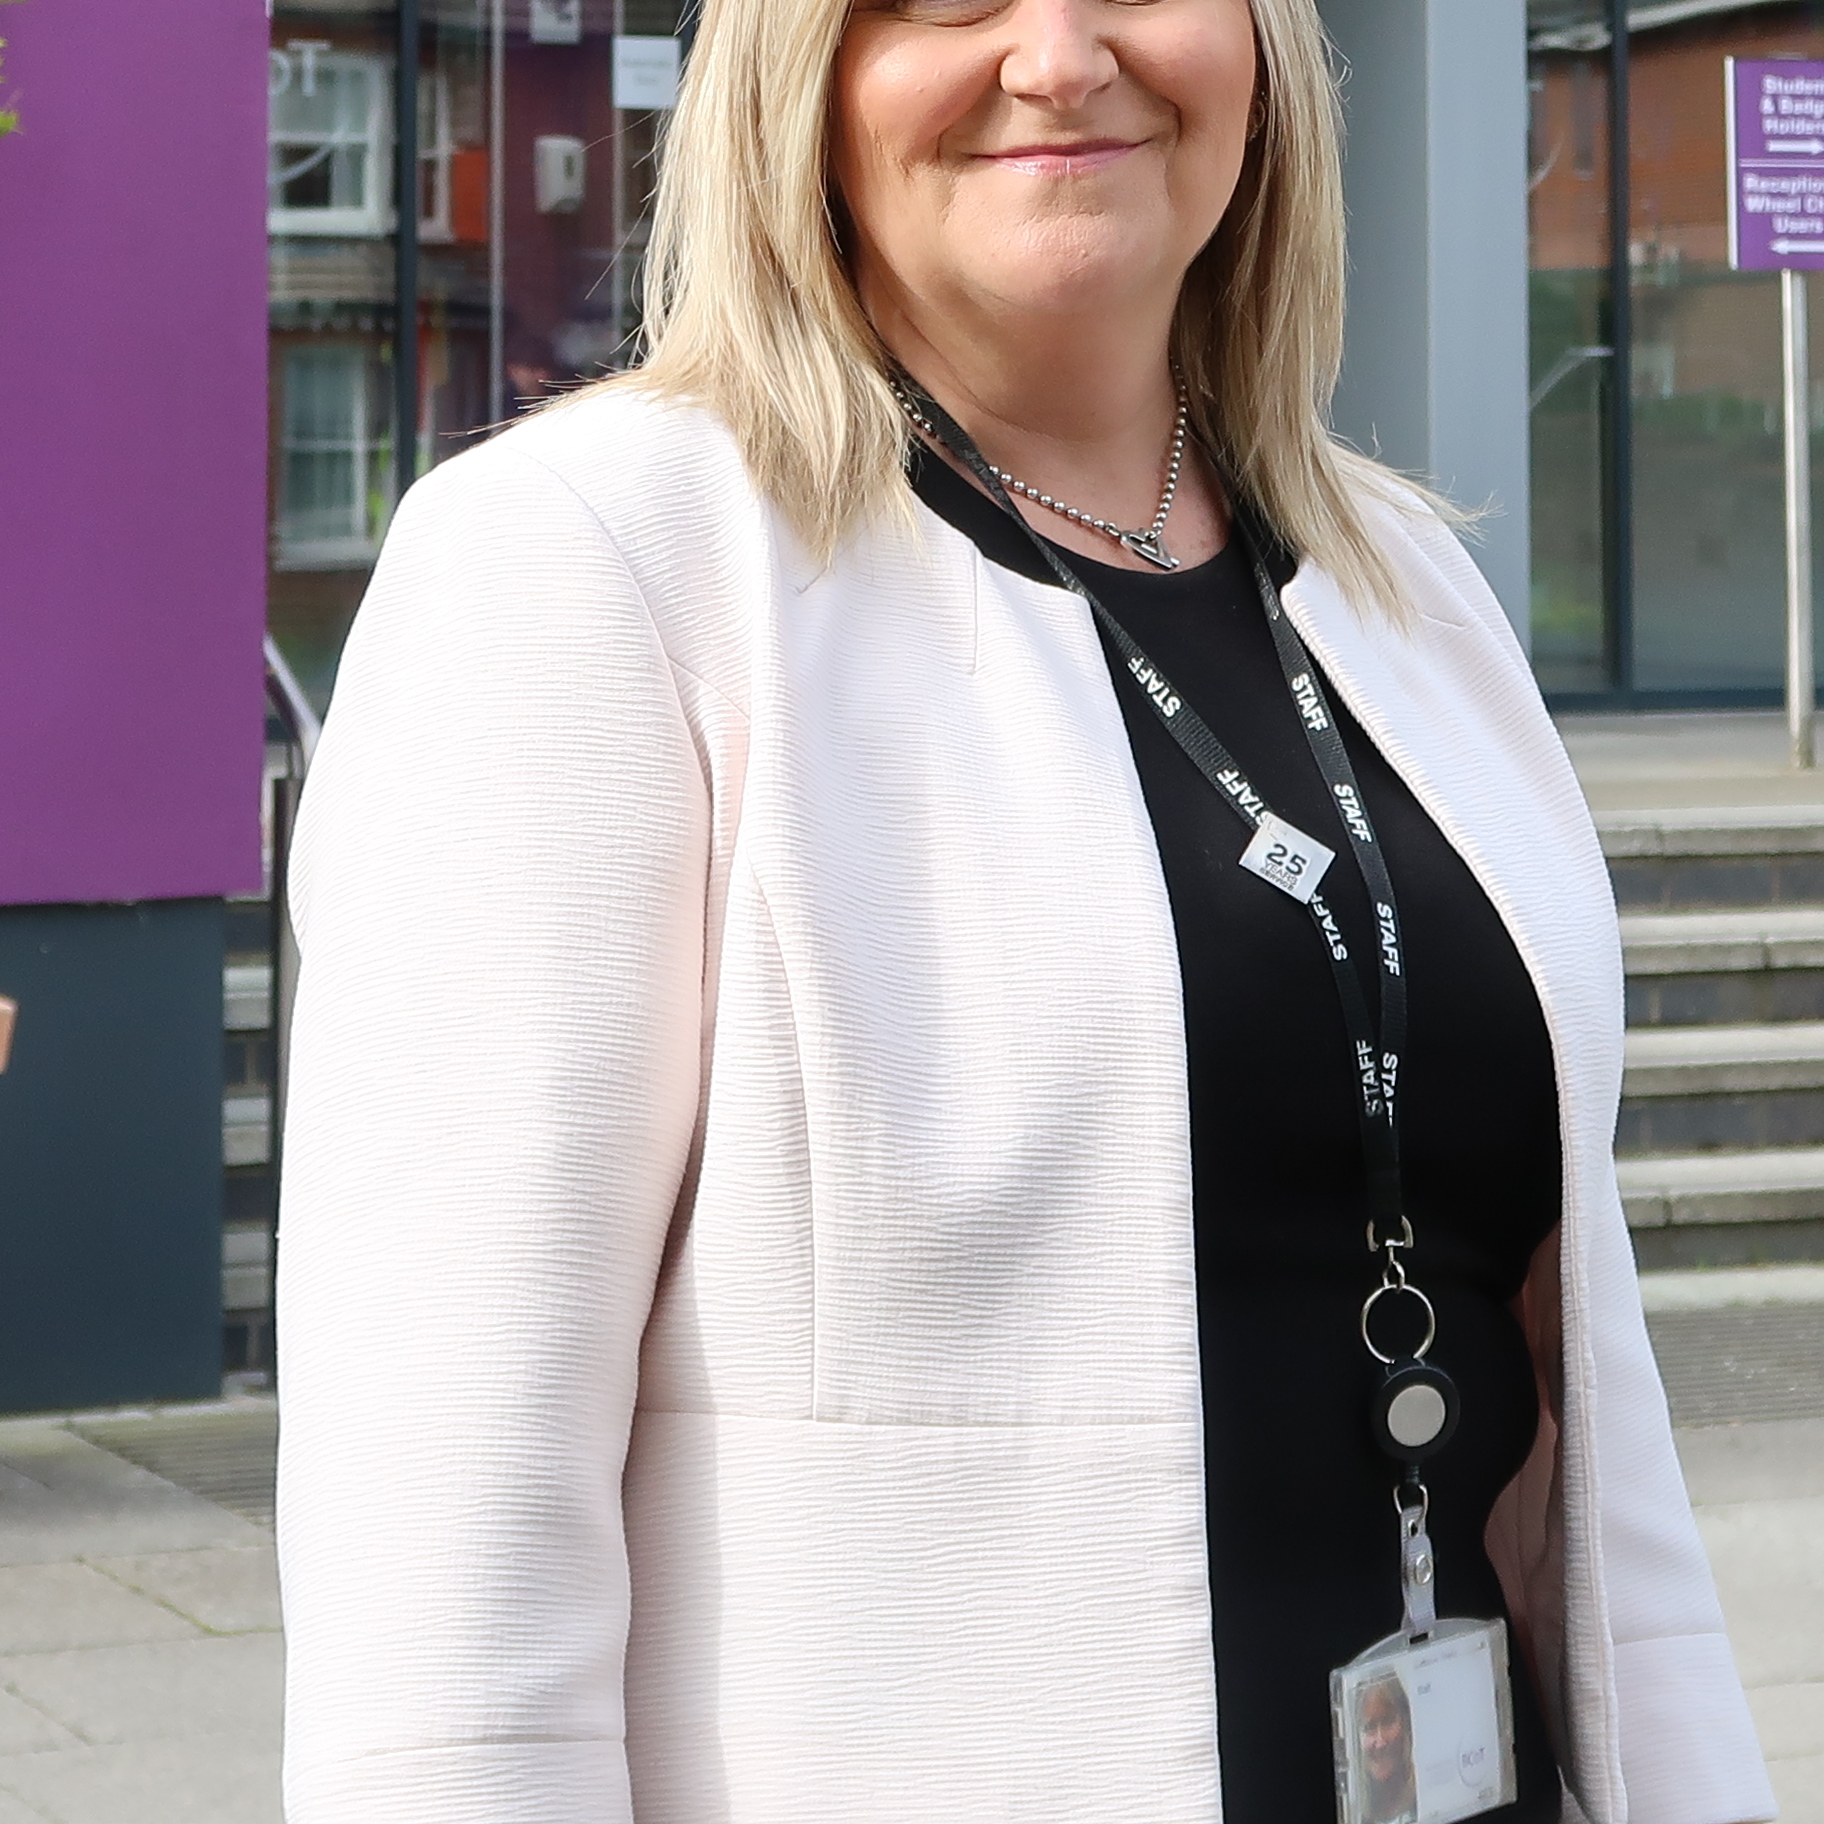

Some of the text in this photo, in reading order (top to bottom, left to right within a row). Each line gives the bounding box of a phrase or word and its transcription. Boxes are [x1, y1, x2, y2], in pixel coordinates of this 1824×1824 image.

[1743, 193, 1803, 213] Wheel
[1127, 656, 1182, 718] STAFF
[1291, 672, 1329, 732] STAFF
[1333, 783, 1373, 844] STAFF
[1266, 843, 1307, 876] 25
[1376, 901, 1401, 977] STAFF
[1355, 1039, 1385, 1118] STAFF
